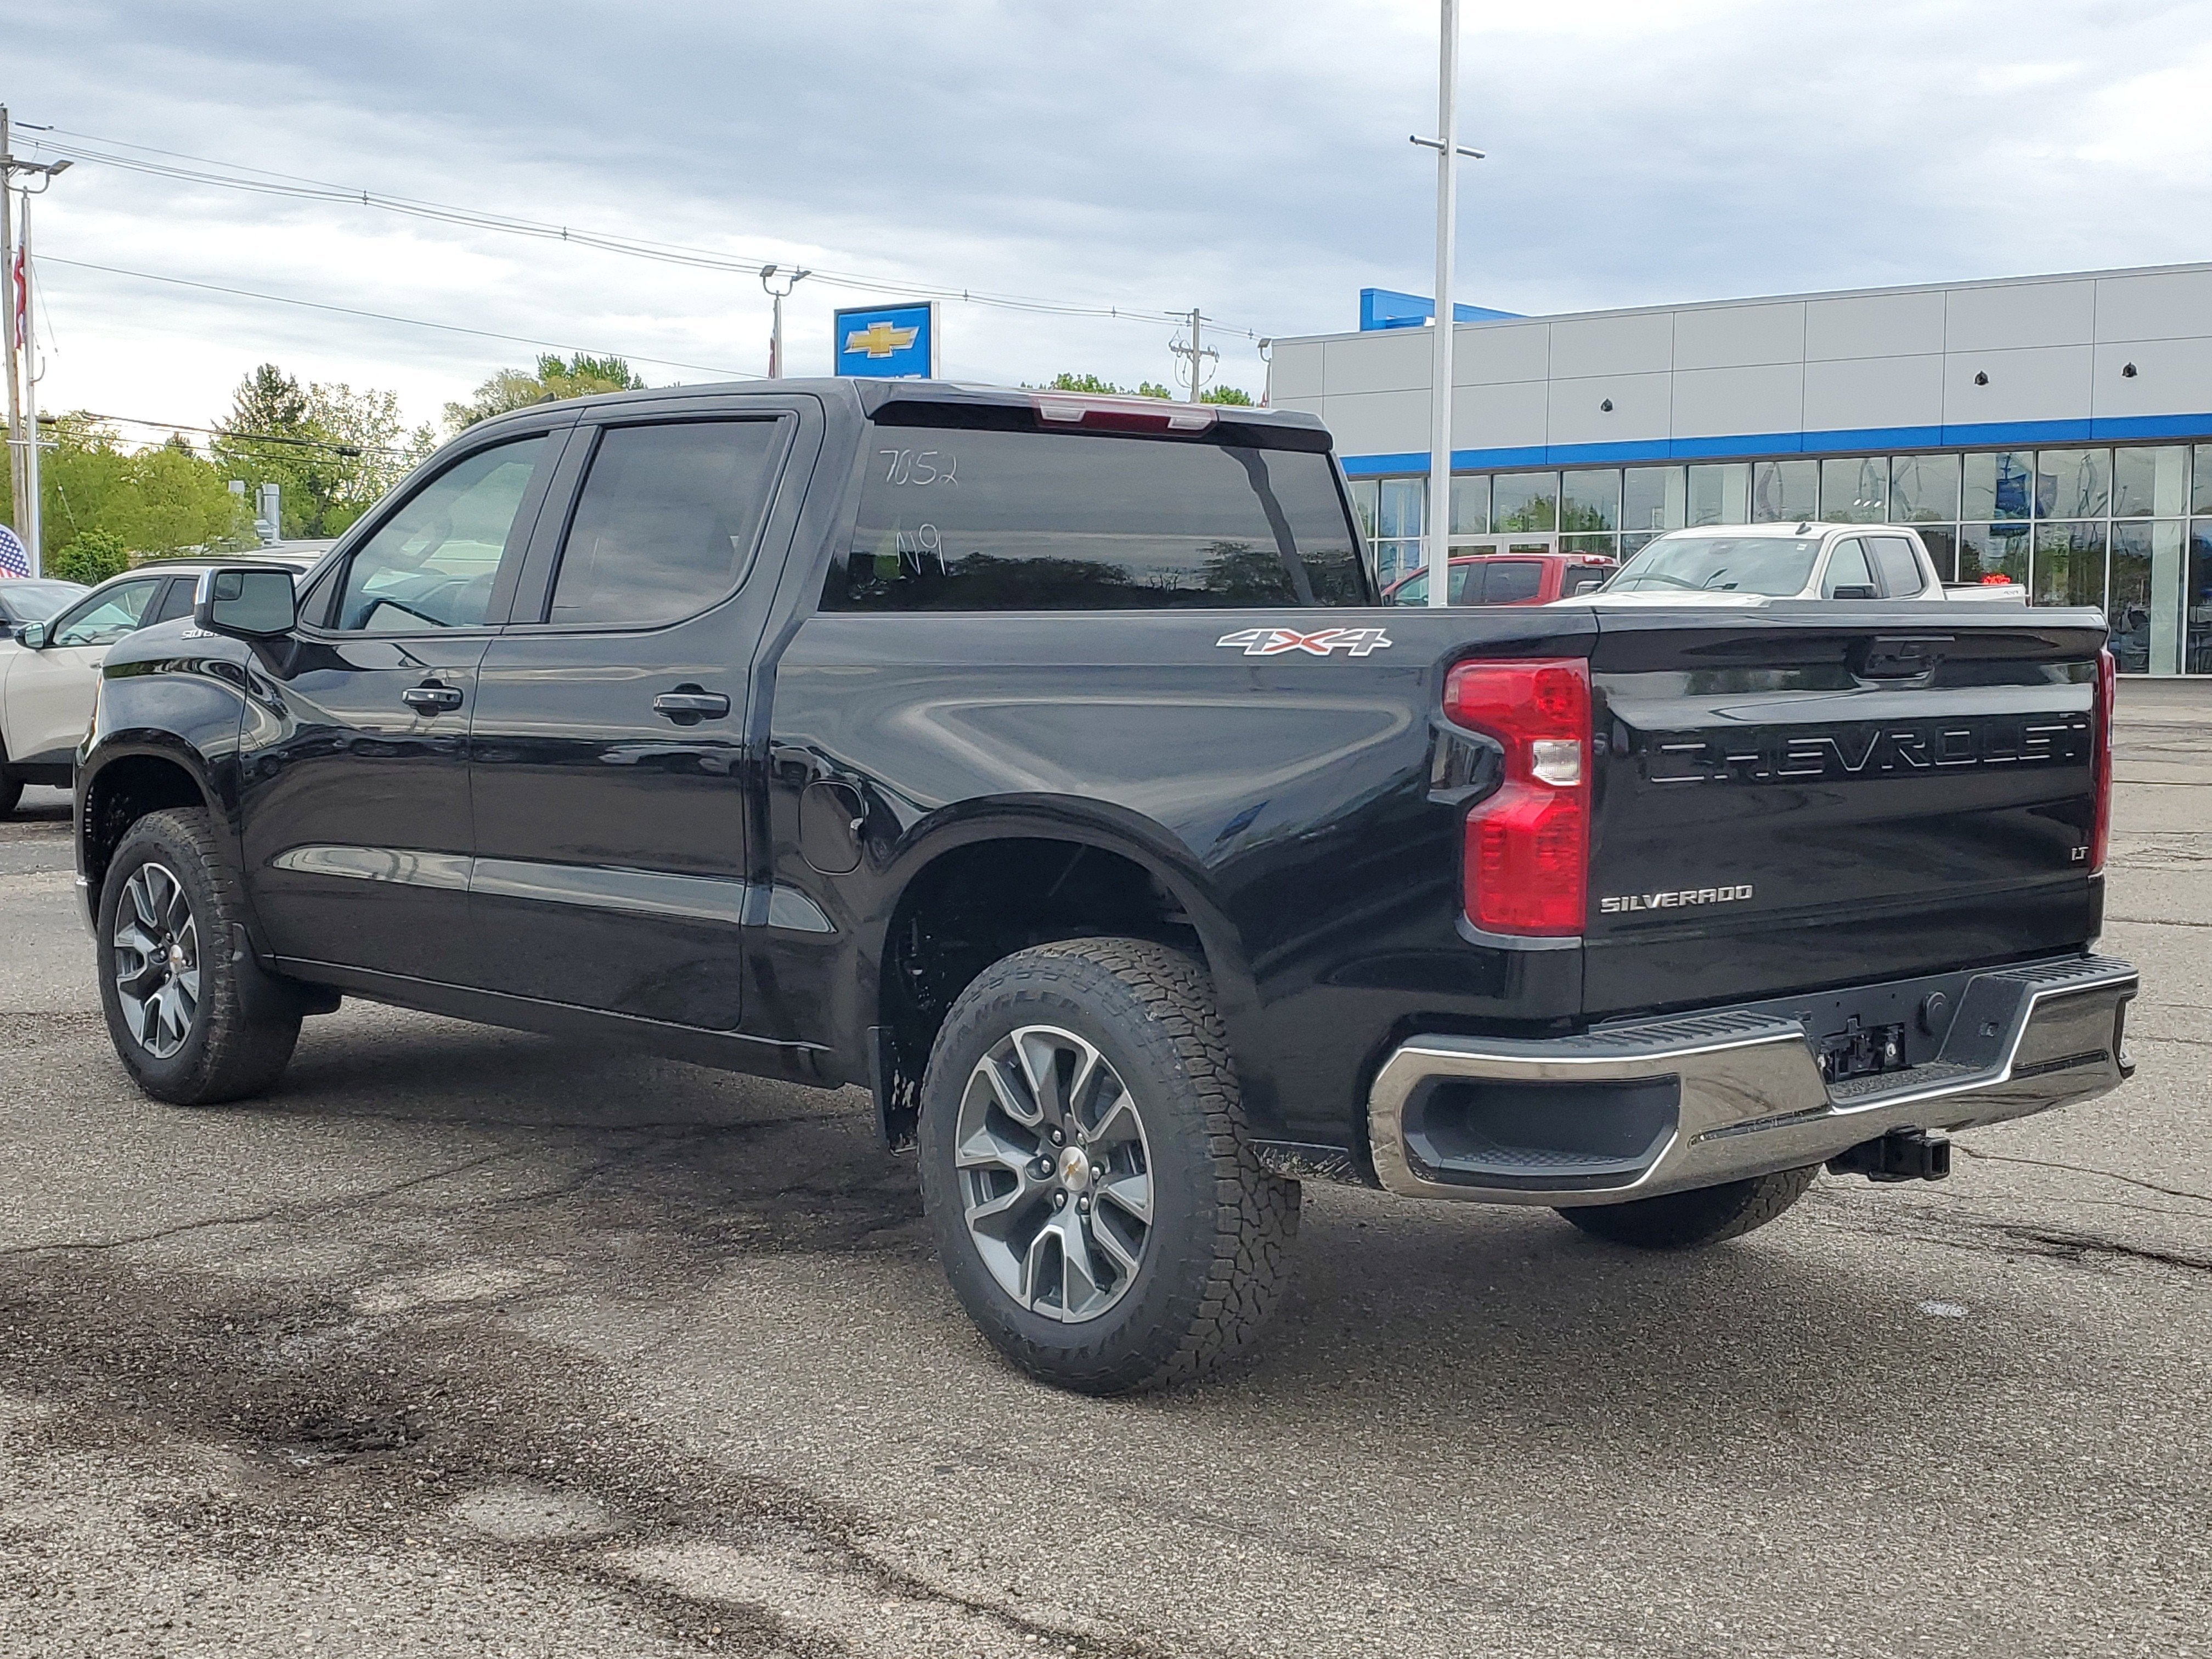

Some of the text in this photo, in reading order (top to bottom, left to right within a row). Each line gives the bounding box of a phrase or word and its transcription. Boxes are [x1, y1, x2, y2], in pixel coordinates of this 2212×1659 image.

[1649, 714, 2087, 782] CHEVROLET
[2071, 846, 2089, 861] LT
[1600, 884, 1753, 913] SILVERADO
